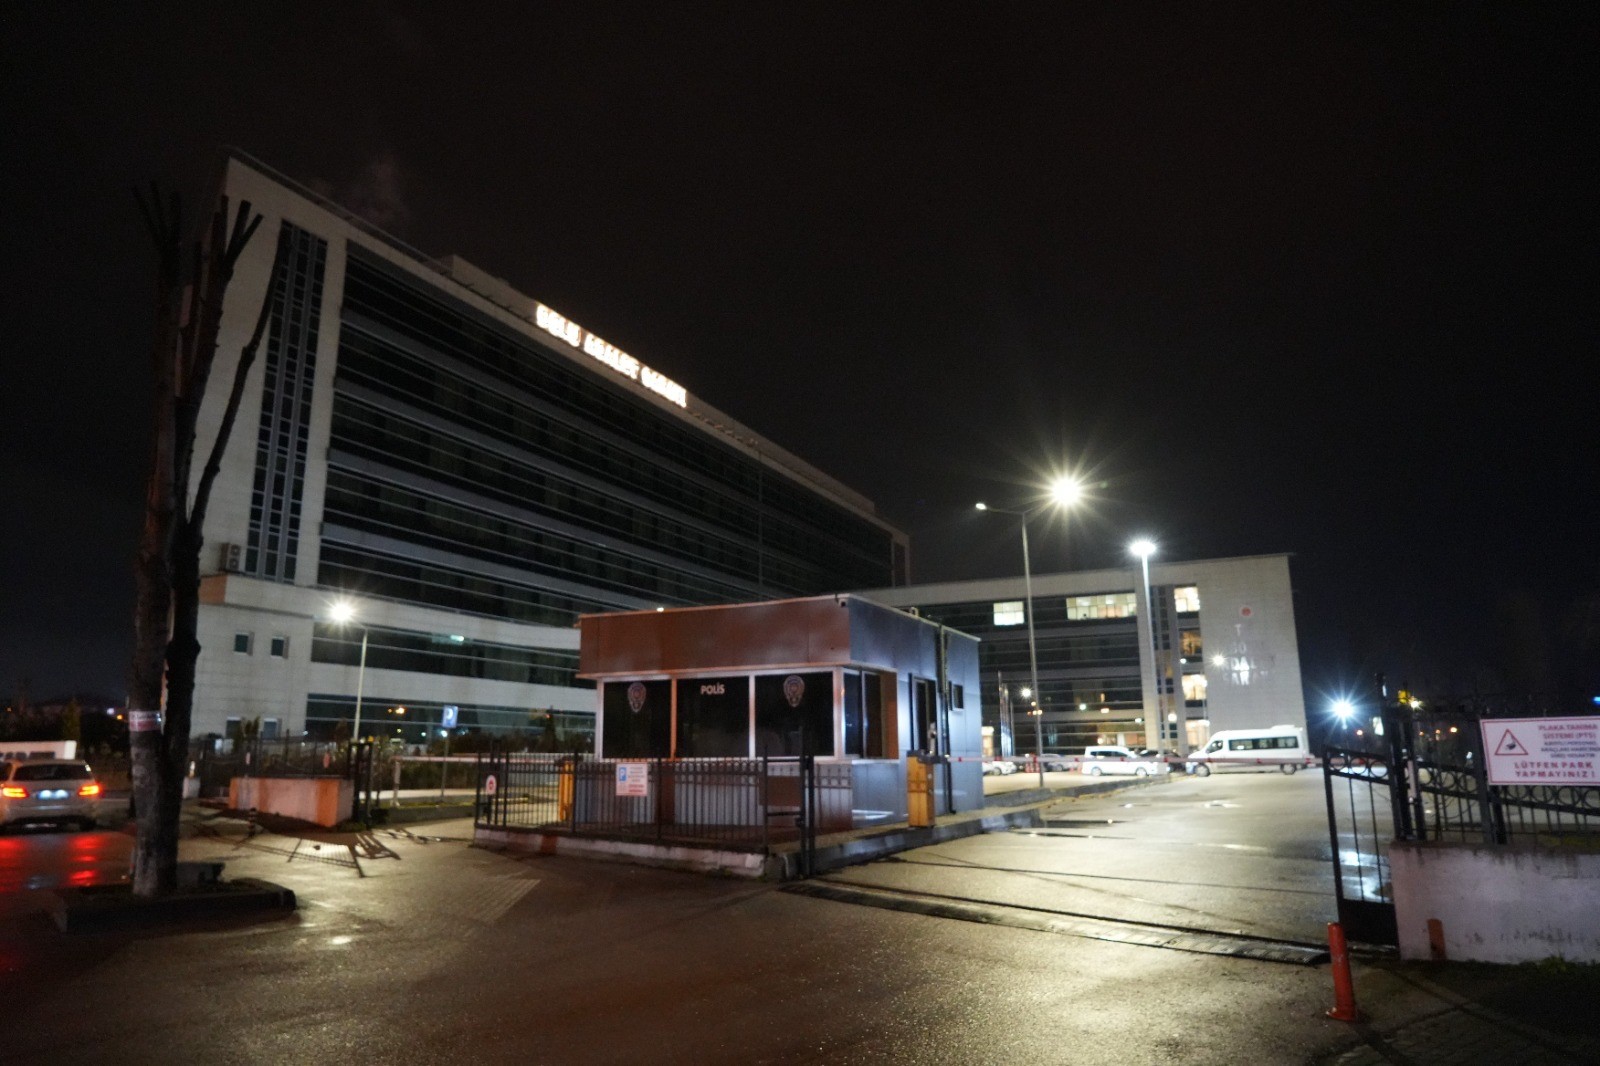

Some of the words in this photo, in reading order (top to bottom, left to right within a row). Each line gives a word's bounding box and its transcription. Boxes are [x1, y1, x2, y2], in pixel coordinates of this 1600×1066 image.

[700, 682, 725, 695] POLİS
[1515, 760, 1559, 769] LÜTFEN
[1561, 761, 1594, 769] PARK
